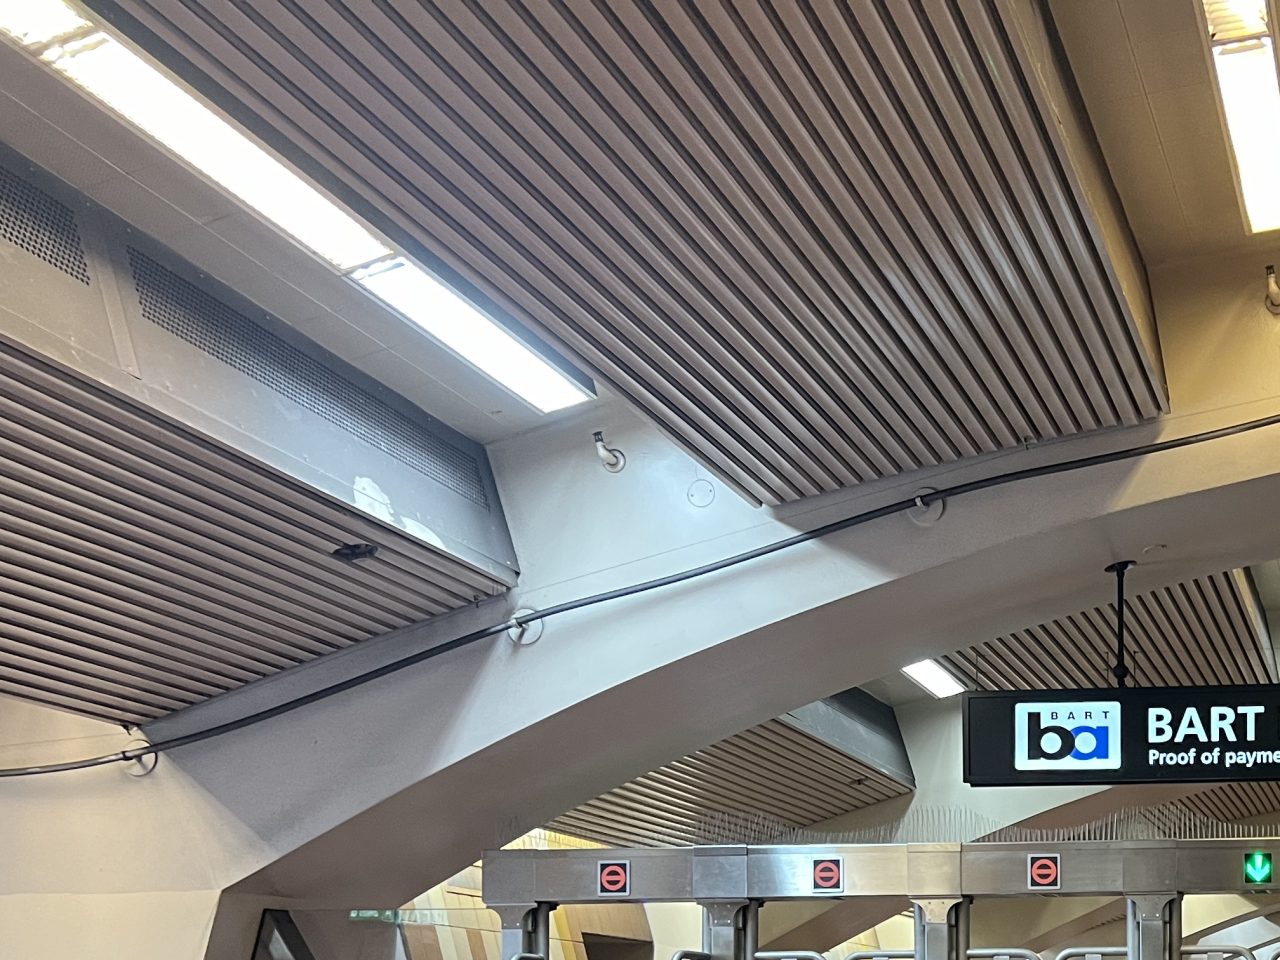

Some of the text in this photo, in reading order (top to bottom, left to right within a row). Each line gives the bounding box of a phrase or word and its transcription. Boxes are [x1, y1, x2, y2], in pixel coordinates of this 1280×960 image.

[1051, 711, 1109, 720] BART
[1147, 706, 1265, 743] BART
[1148, 748, 1196, 765] Proof
[1200, 748, 1220, 765] of
